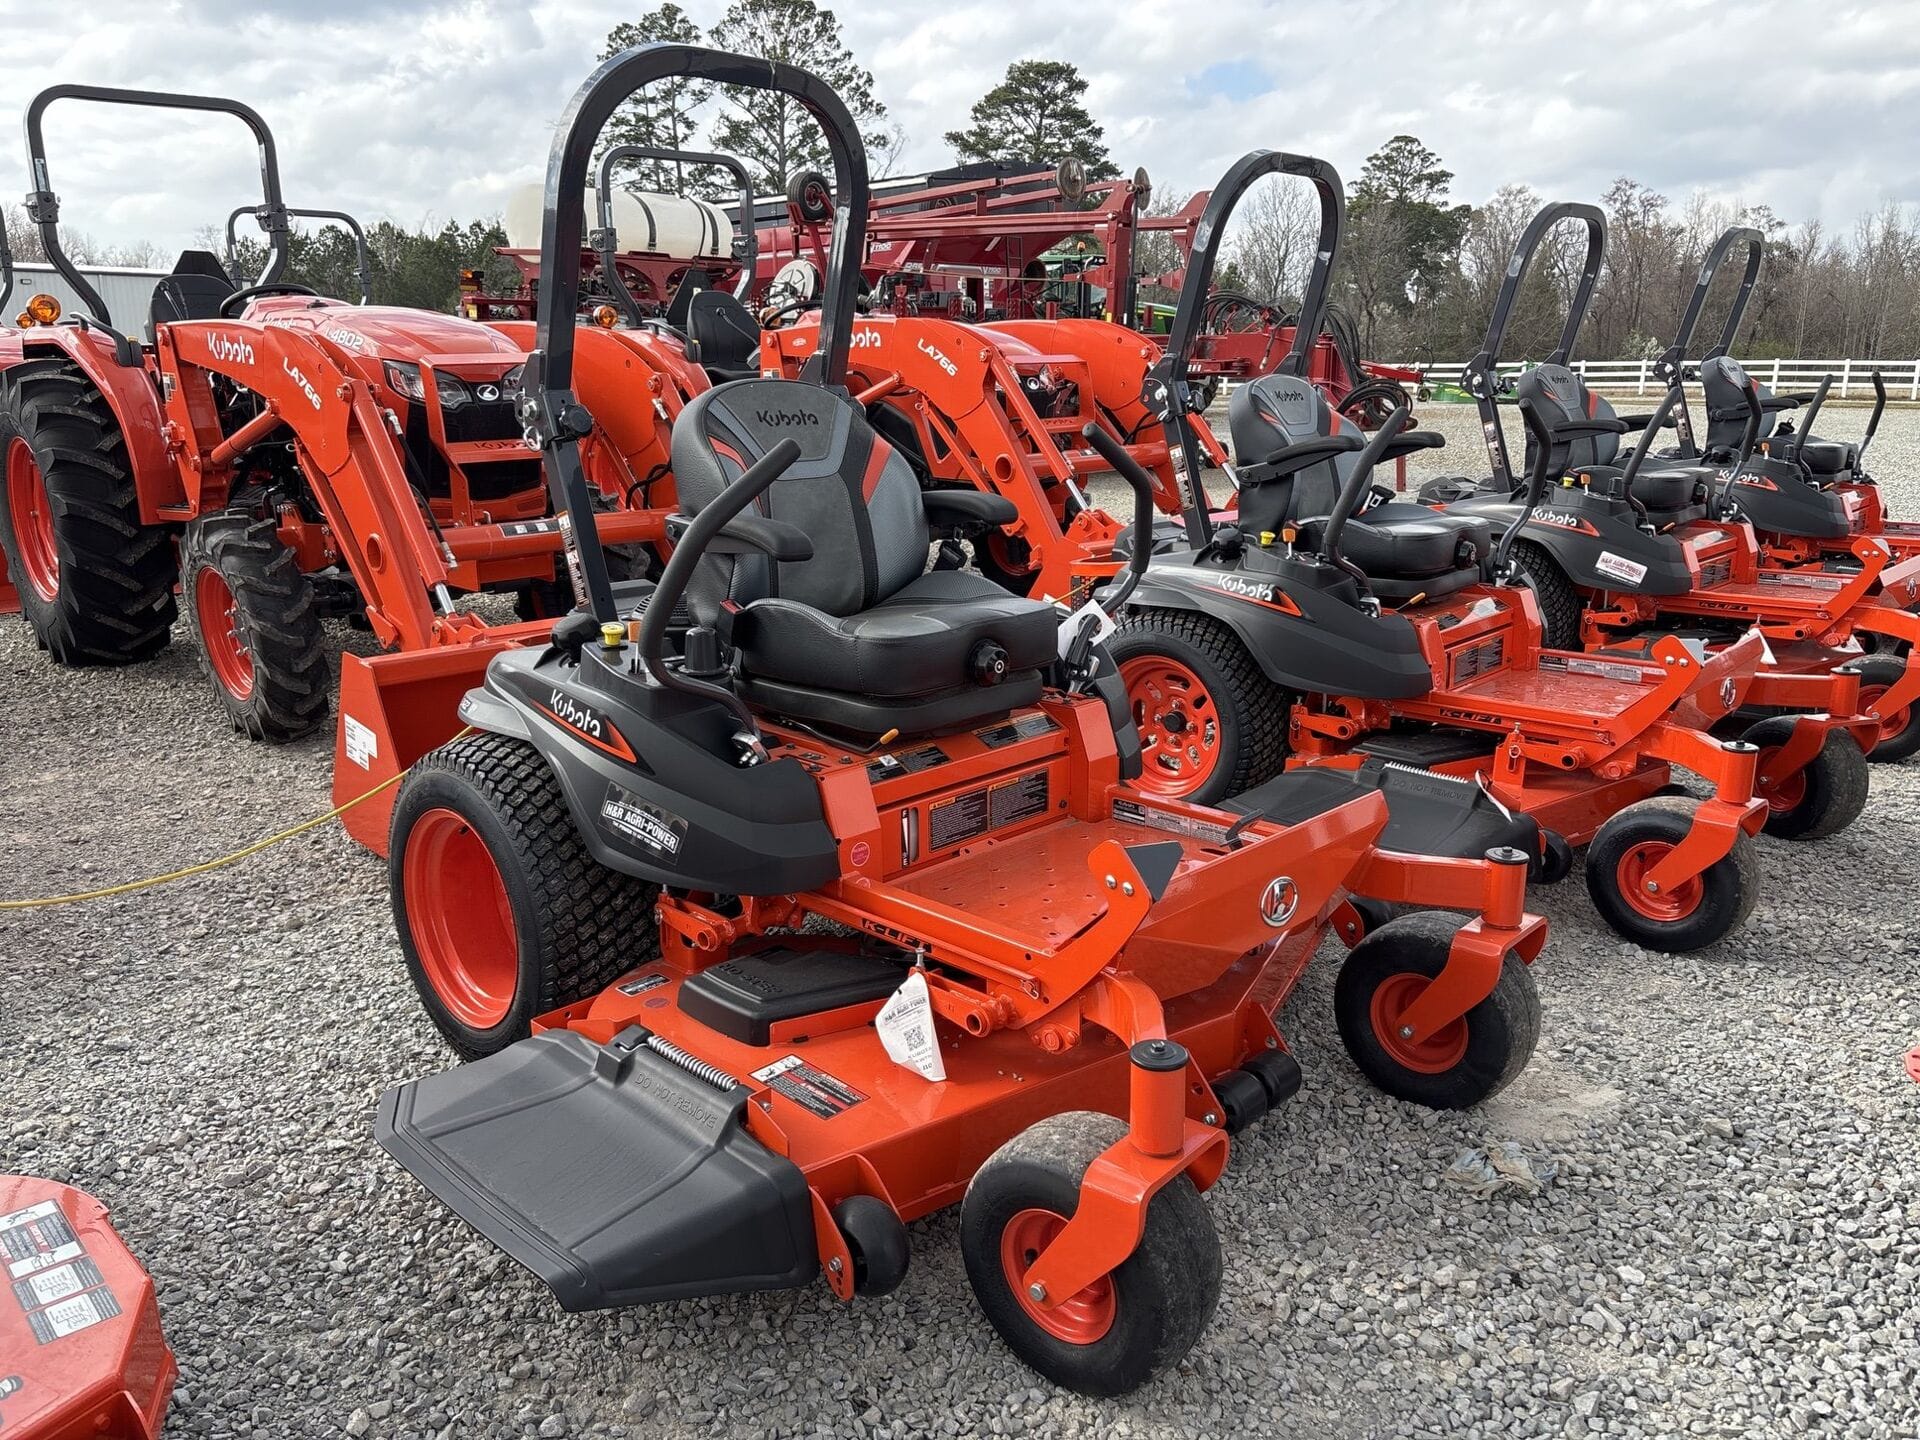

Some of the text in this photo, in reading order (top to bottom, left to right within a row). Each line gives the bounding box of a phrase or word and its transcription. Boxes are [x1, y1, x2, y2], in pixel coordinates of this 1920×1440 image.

[207, 331, 255, 366] Kubota
[917, 338, 958, 377] LA766
[283, 356, 322, 411] LA766
[1273, 390, 1304, 402] Kubota
[756, 409, 819, 427] Kubota
[1531, 507, 1578, 528] Kubota
[1217, 574, 1273, 602] Kubota
[550, 688, 601, 738] Kubota
[1441, 709, 1501, 723] K-LIFT
[605, 803, 624, 819] H&R
[624, 811, 677, 850] AGRI-POWER
[864, 920, 925, 949] K-LIFT
[635, 1073, 718, 1129] DO NOT REMOVE
